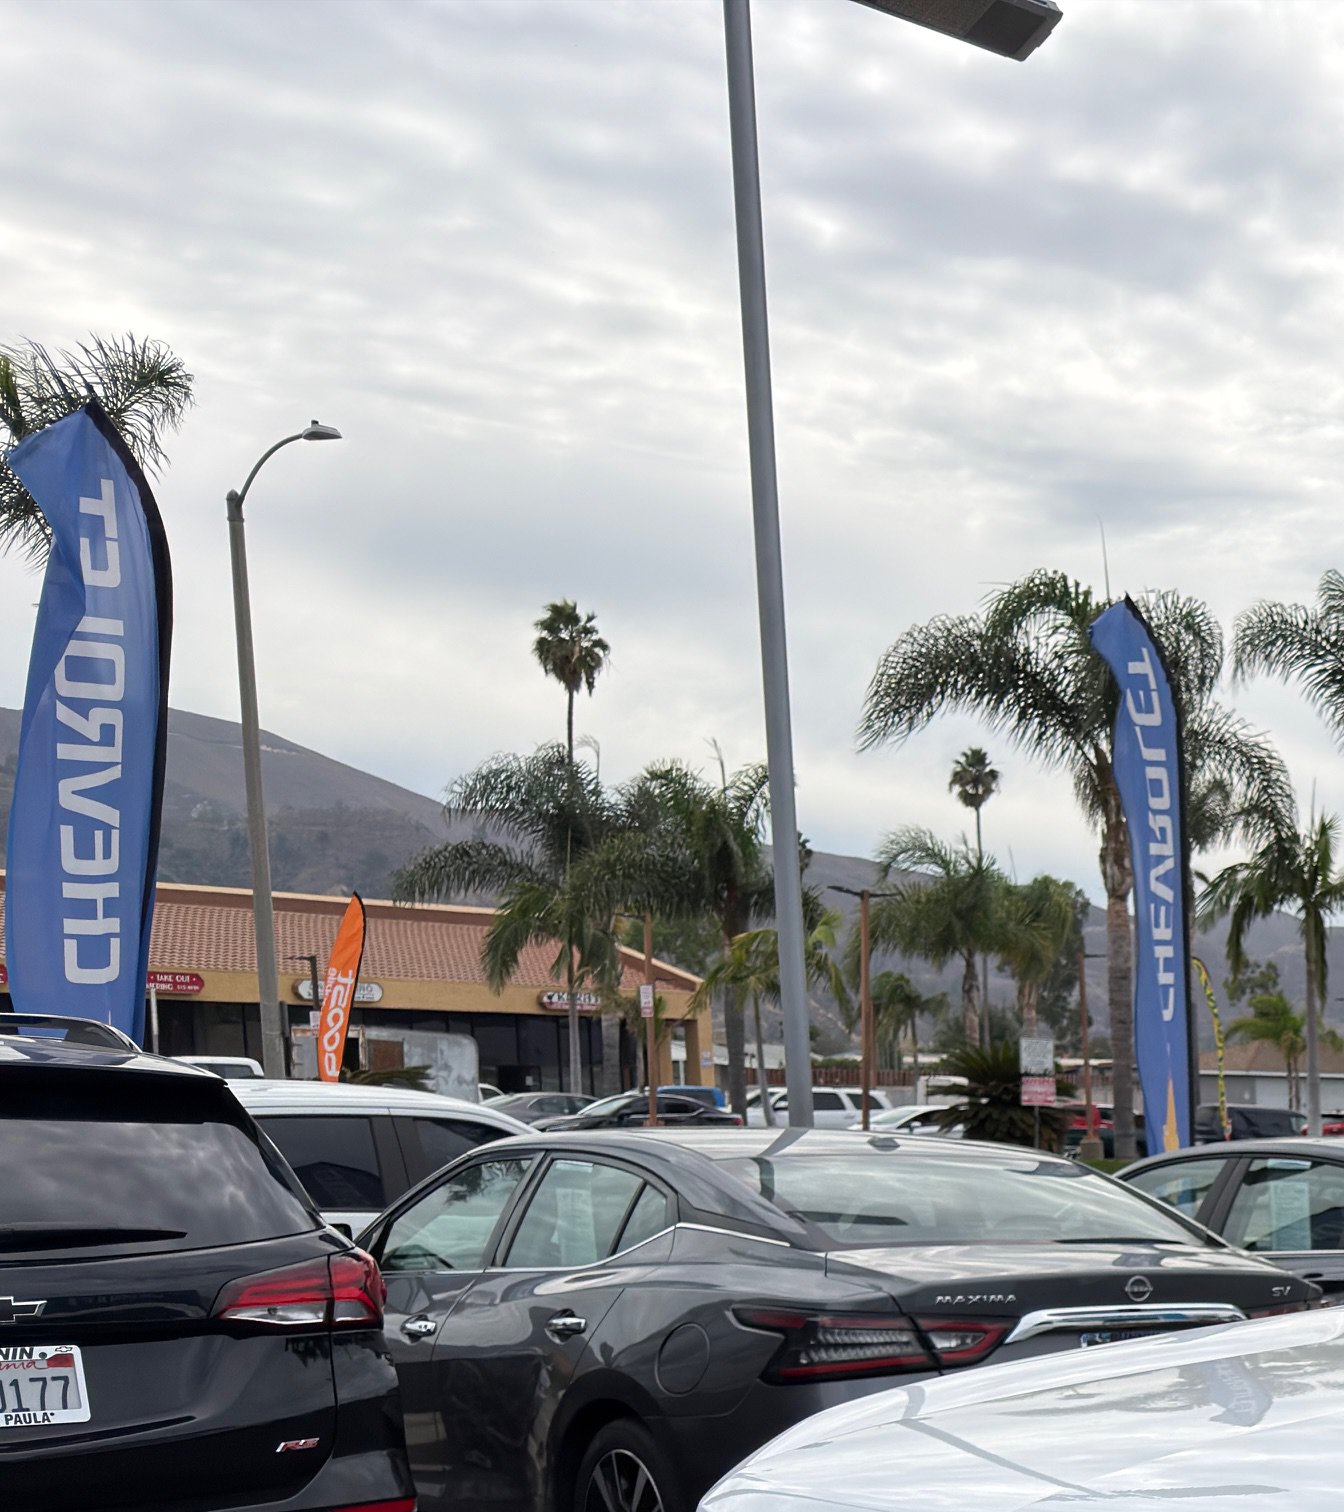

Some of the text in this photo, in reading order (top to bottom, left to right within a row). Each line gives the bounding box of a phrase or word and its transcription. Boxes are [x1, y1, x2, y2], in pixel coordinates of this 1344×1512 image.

[156, 974, 190, 983] TAKE OUT
[1271, 1286, 1291, 1297] SV
[935, 1294, 1017, 1305] MAXIMA
[4, 1412, 51, 1425] PAULA
[275, 1437, 320, 1453] RS
